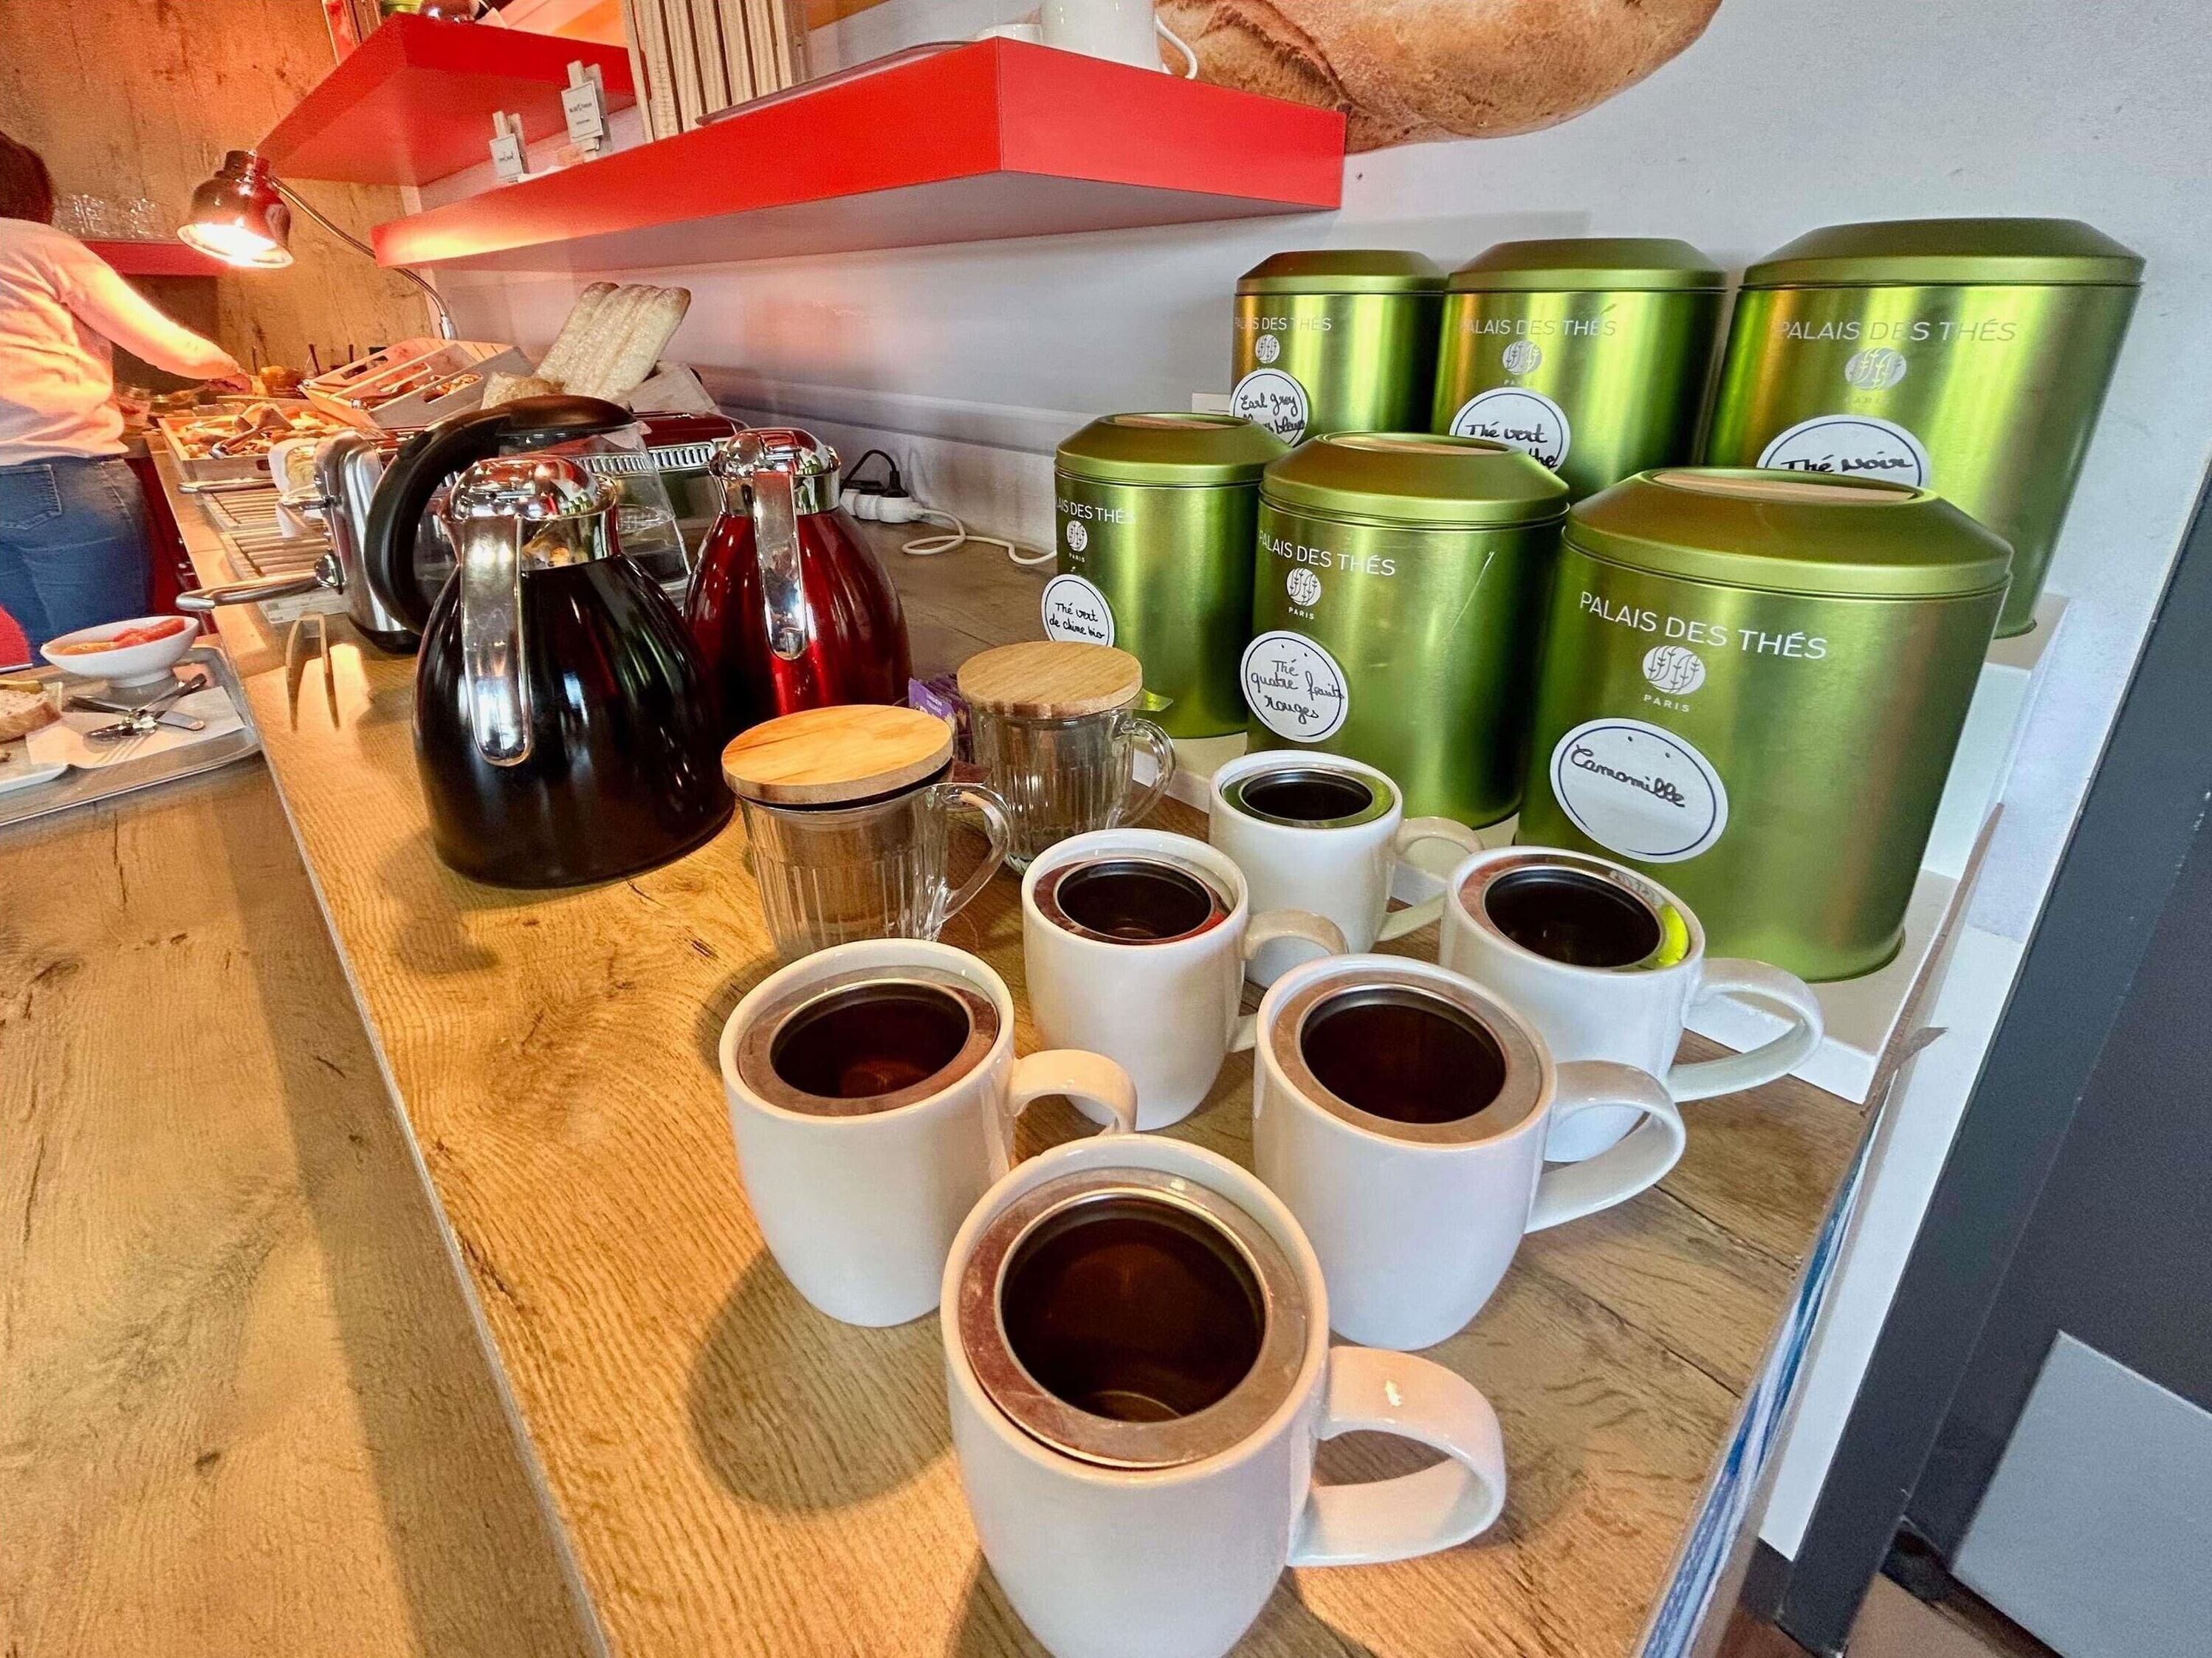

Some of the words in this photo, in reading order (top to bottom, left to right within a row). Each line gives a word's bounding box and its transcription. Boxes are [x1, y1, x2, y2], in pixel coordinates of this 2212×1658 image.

[1262, 317, 1287, 330] DES
[1517, 320, 1555, 336] DES
[1778, 321, 1861, 340] PALAIS
[1869, 321, 1931, 341] DES
[1940, 318, 2017, 342] THÉS
[1240, 392, 1268, 410] Earl
[1465, 422, 1500, 438] Thé
[1780, 454, 1834, 472] Thé
[1071, 502, 1093, 519] DES
[1095, 507, 1135, 524] THÉ
[1258, 531, 1293, 558] PALAIS
[1296, 546, 1332, 568] DES
[1337, 554, 1396, 577] THÉS
[1055, 602, 1073, 616] Thé
[1288, 607, 1315, 621] PARIS
[1049, 613, 1060, 627] de
[1580, 591, 1658, 633] PALAIS
[1665, 616, 1728, 647] DES
[1738, 631, 1828, 659] THÉS
[1271, 659, 1299, 677] Thé
[1251, 672, 1299, 693] quatre
[1643, 693, 1691, 713] PARIS
[1570, 744, 1686, 808] Camomille
